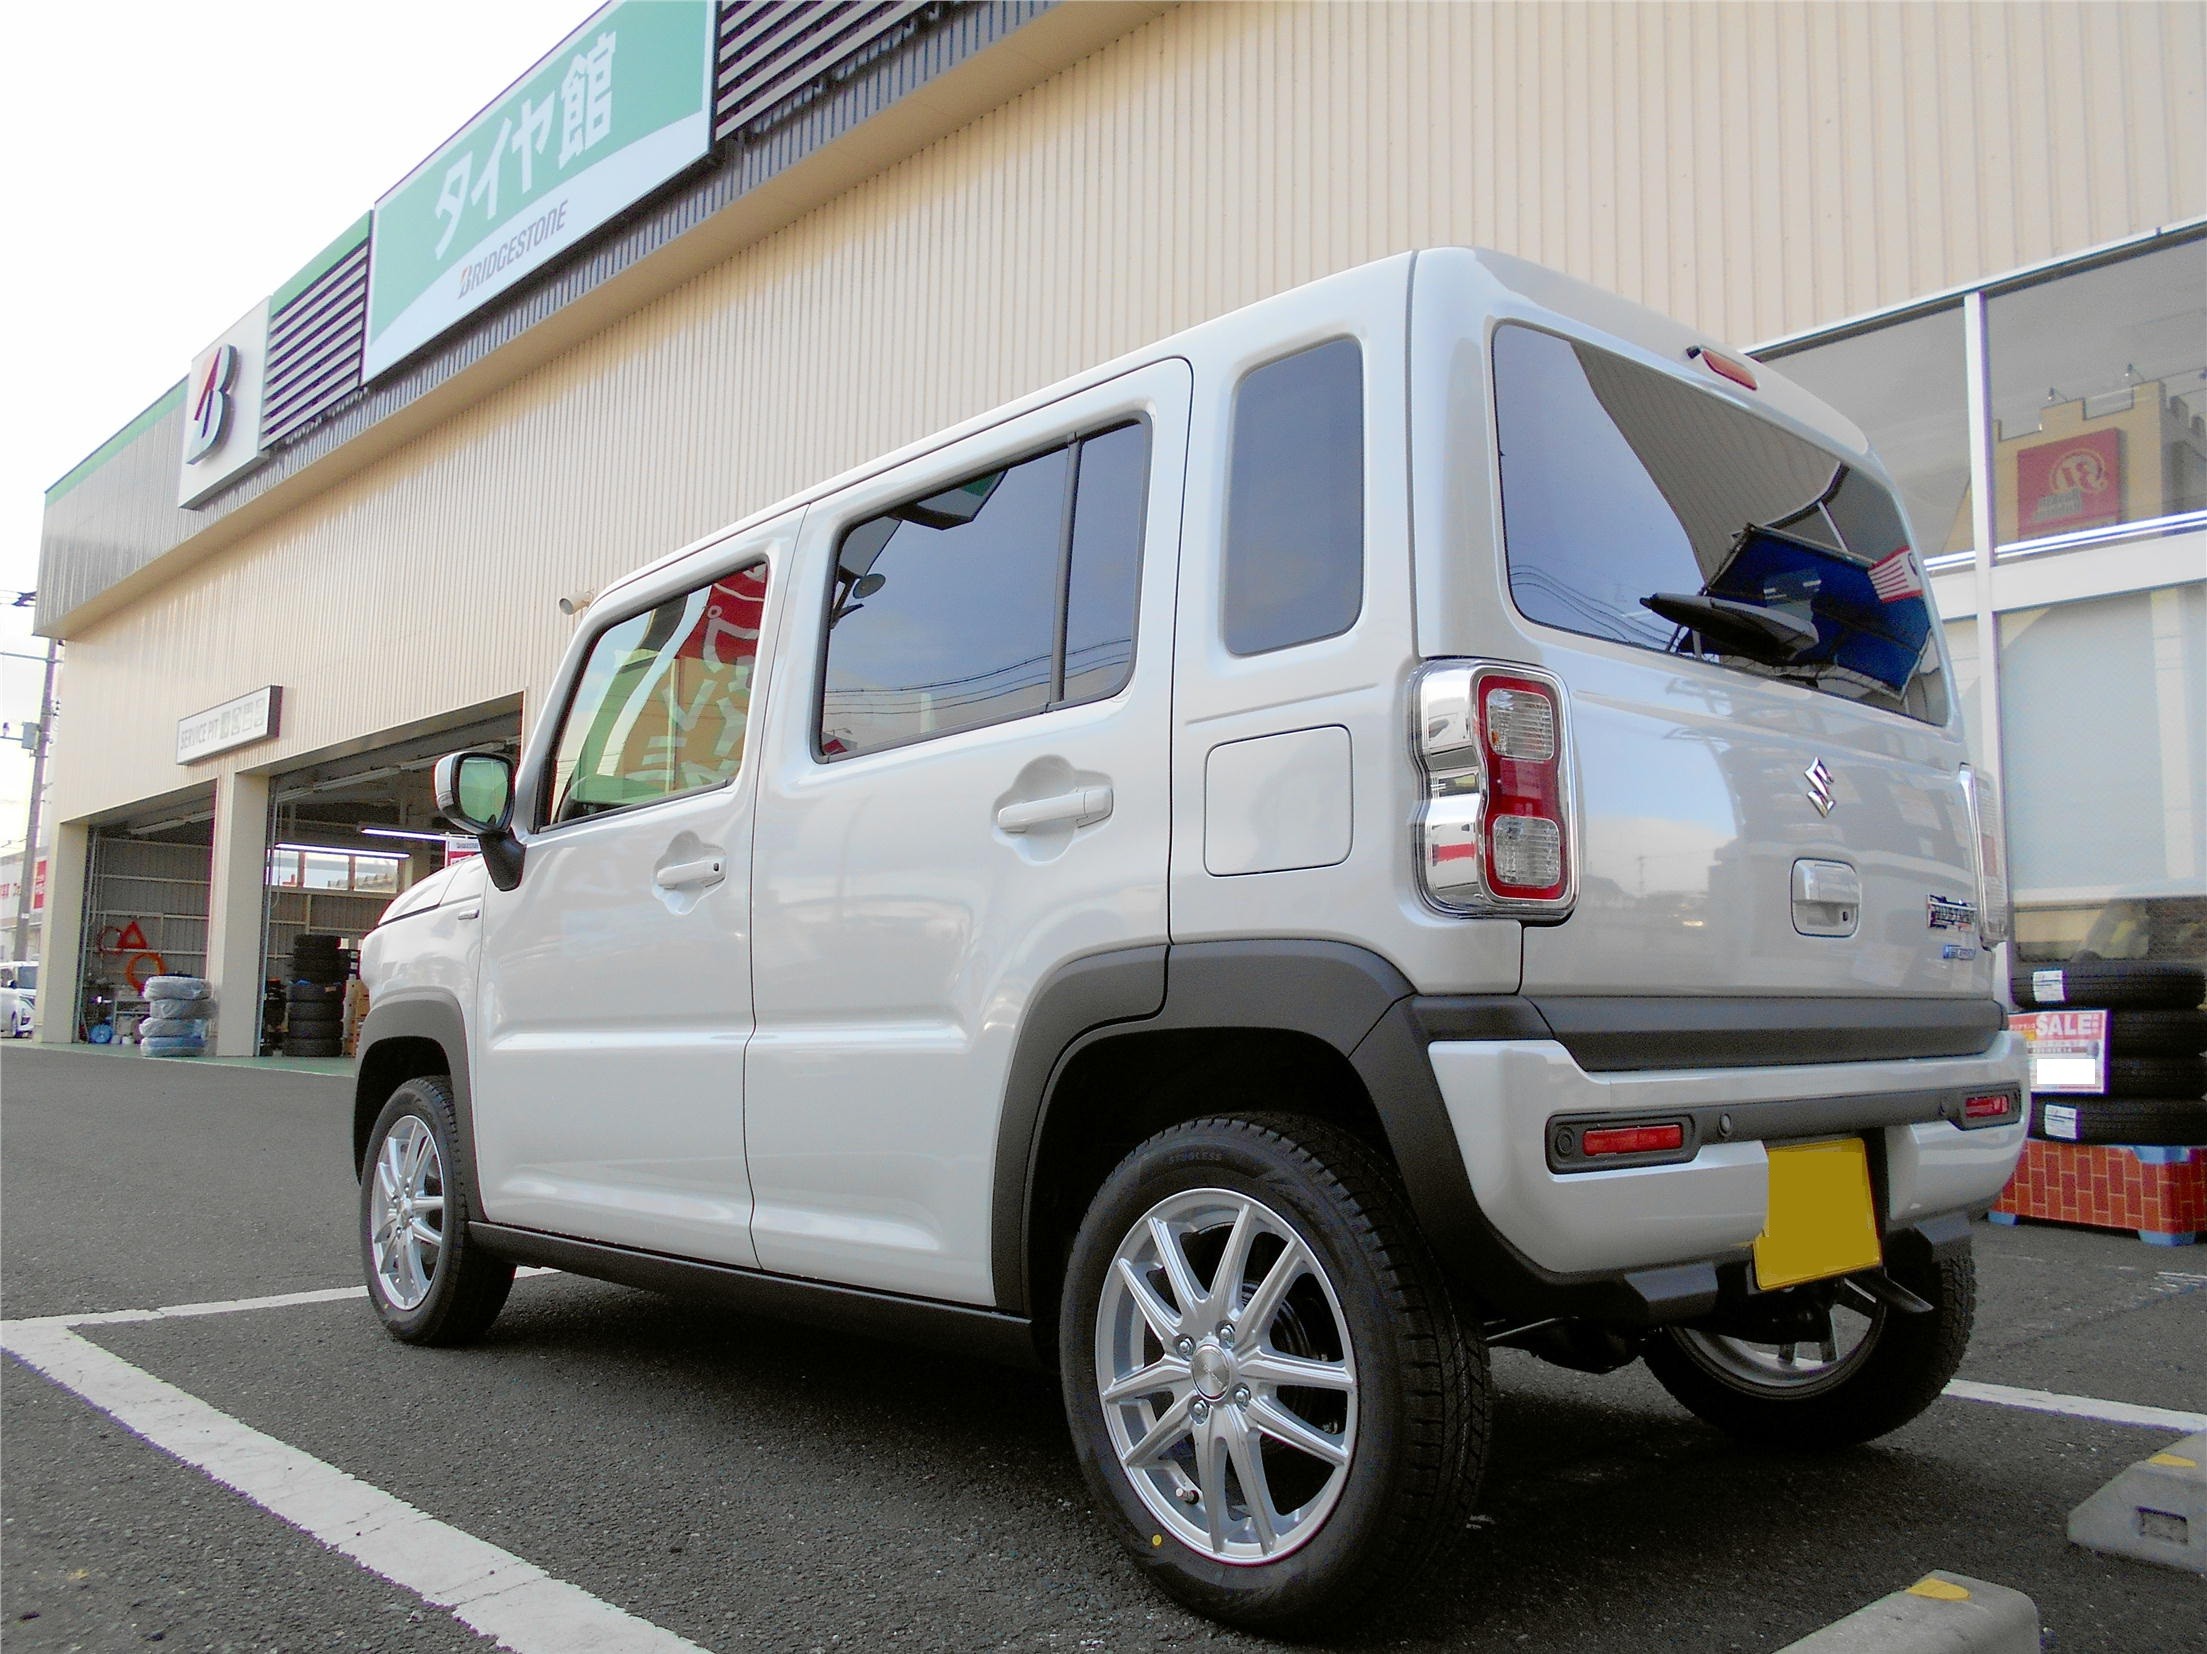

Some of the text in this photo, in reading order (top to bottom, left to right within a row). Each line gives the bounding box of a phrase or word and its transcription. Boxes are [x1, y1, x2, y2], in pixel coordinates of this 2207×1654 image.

[434, 30, 617, 261] タイヤ館
[457, 199, 569, 299] BRIDGESTONE
[2035, 1013, 2092, 1036] SALE
